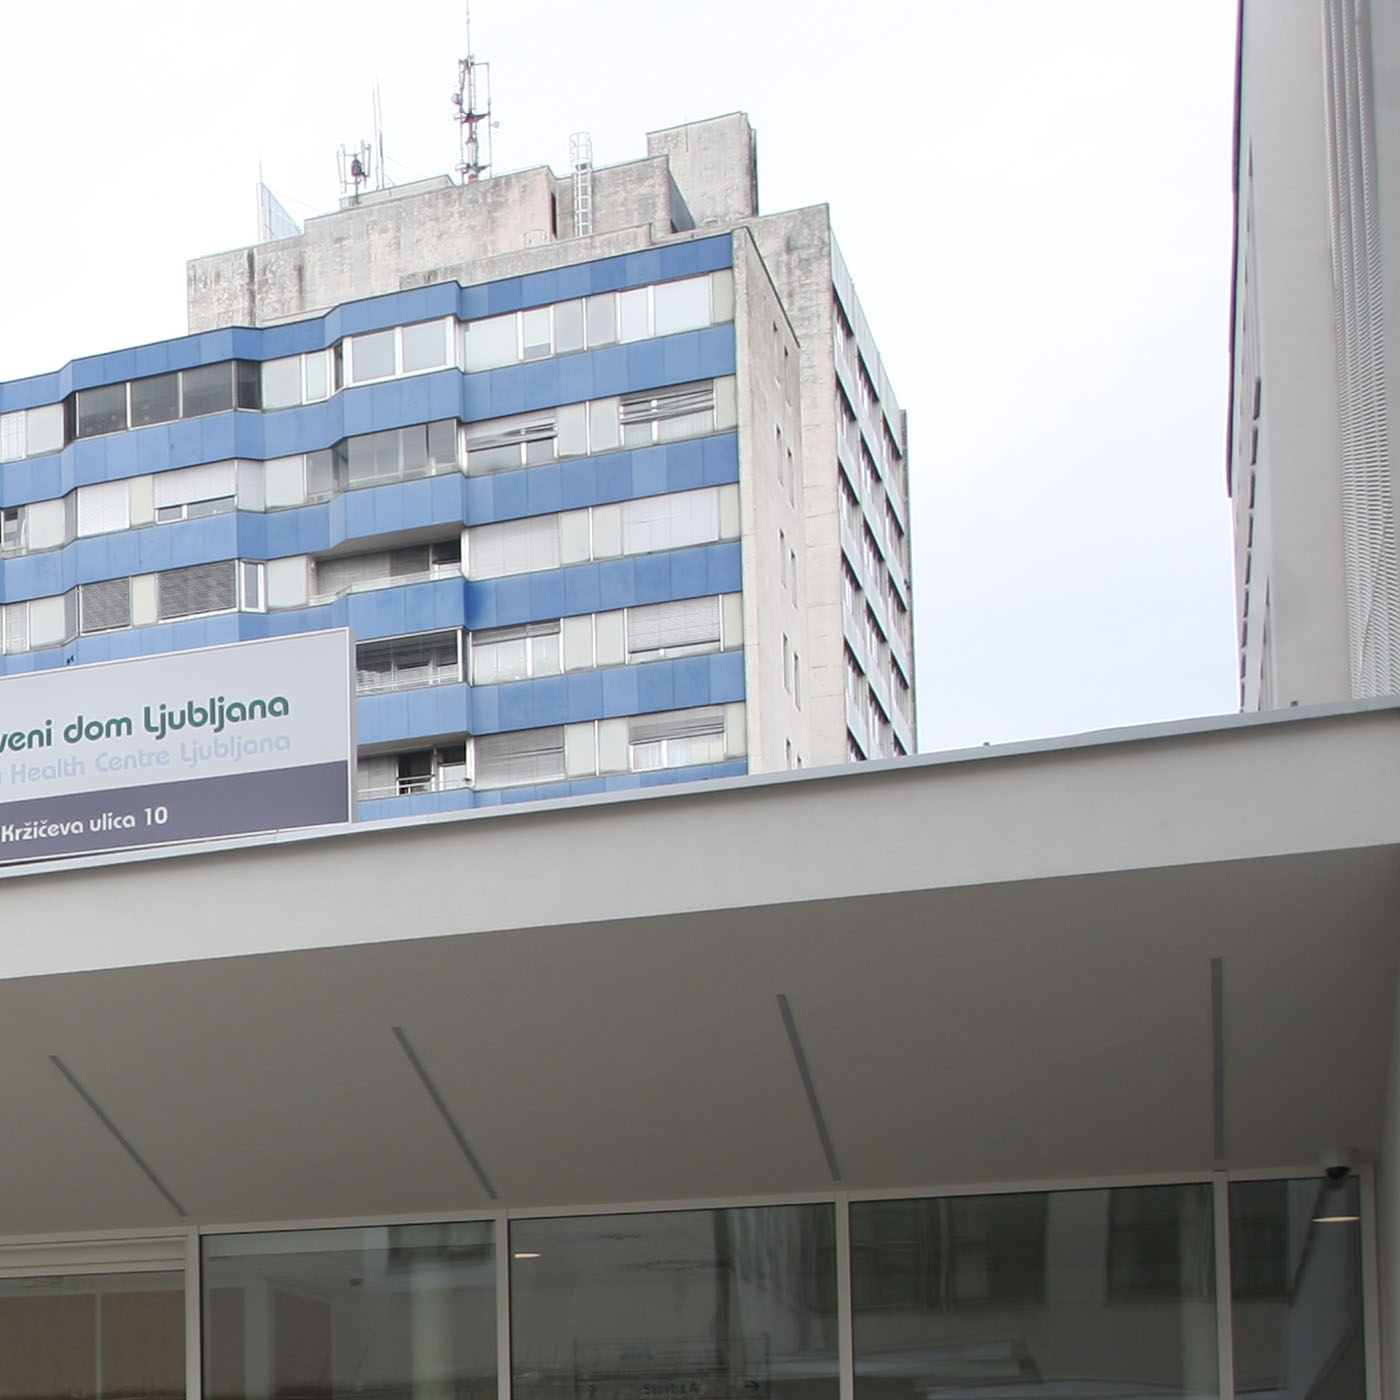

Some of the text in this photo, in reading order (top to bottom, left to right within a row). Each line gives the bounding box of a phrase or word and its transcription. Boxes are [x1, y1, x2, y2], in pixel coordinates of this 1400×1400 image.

[63, 715, 133, 743] dom
[143, 695, 290, 740] Ljubljana
[10, 757, 85, 786] Health
[95, 747, 170, 773] Centre
[180, 732, 291, 767] Ljubljana
[1, 819, 84, 843] Kržičeva
[89, 813, 136, 831] ulica
[143, 806, 169, 826] 10
